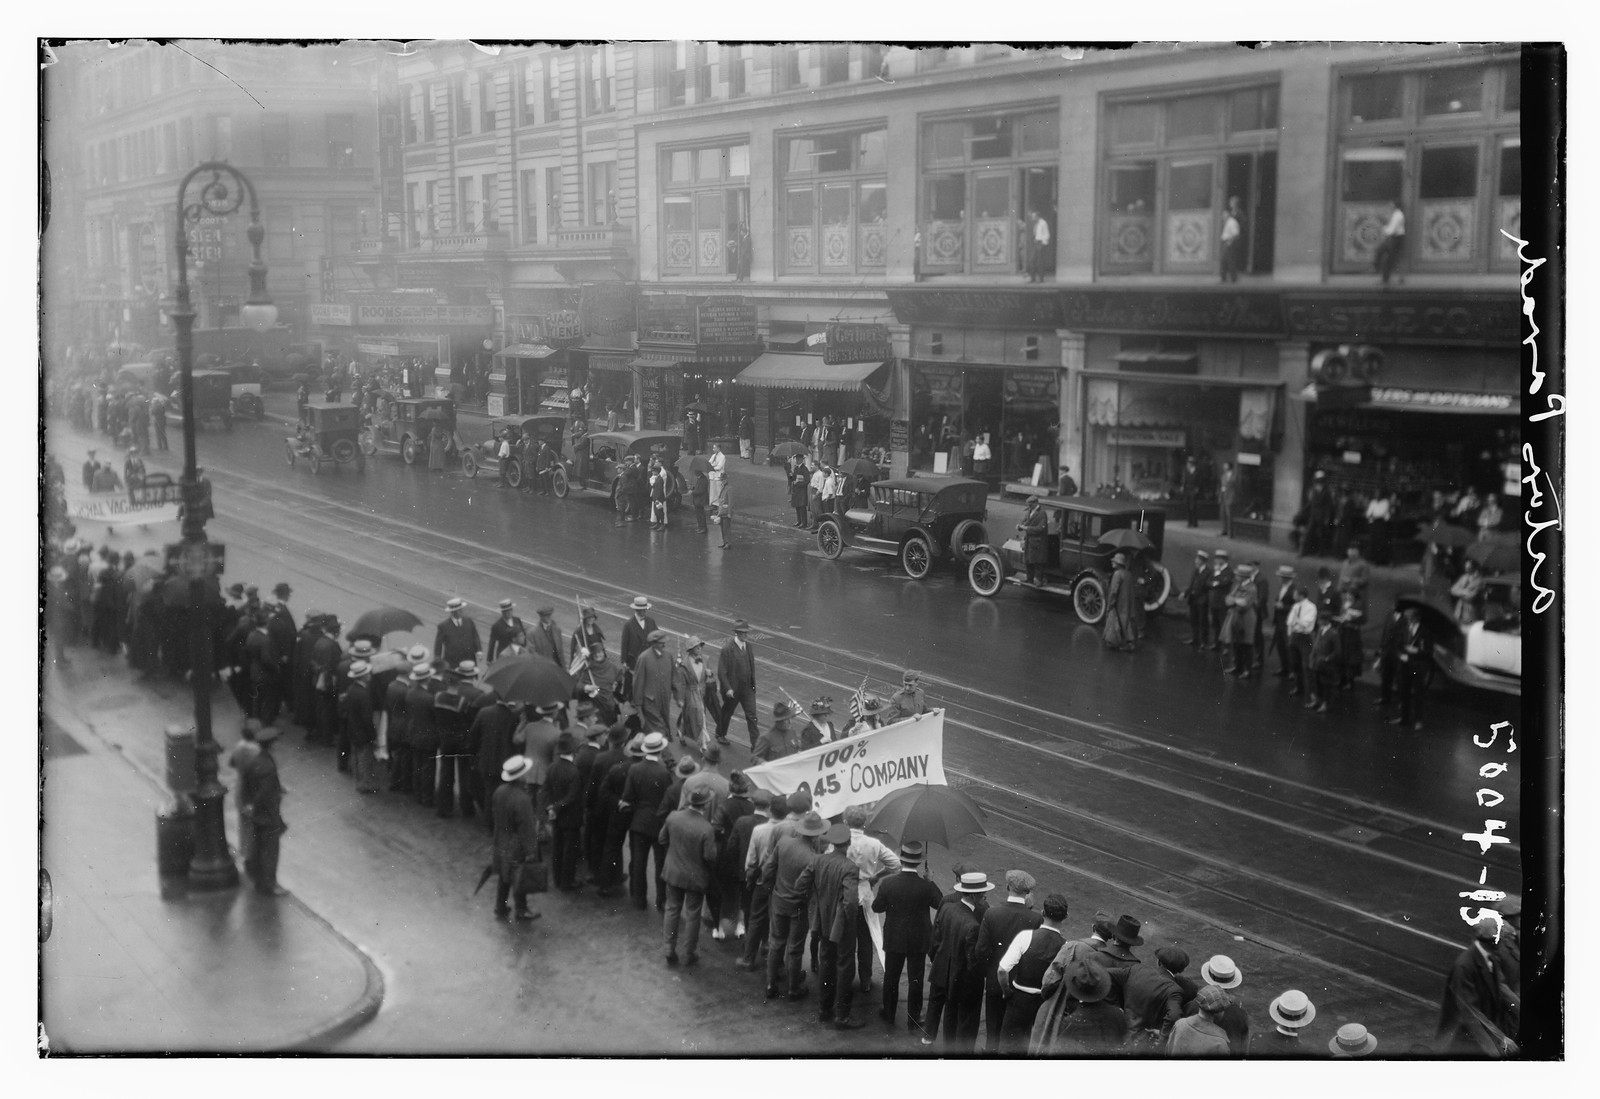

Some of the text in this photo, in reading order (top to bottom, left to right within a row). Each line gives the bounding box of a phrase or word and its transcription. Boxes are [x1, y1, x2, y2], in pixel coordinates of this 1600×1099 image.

[361, 306, 402, 318] ROOMS
[550, 313, 580, 325] JACK
[828, 347, 891, 362] RESTAURANT
[1431, 391, 1512, 409] OPTICIANS
[818, 740, 869, 771] 100%
[850, 754, 930, 793] COMPANY
